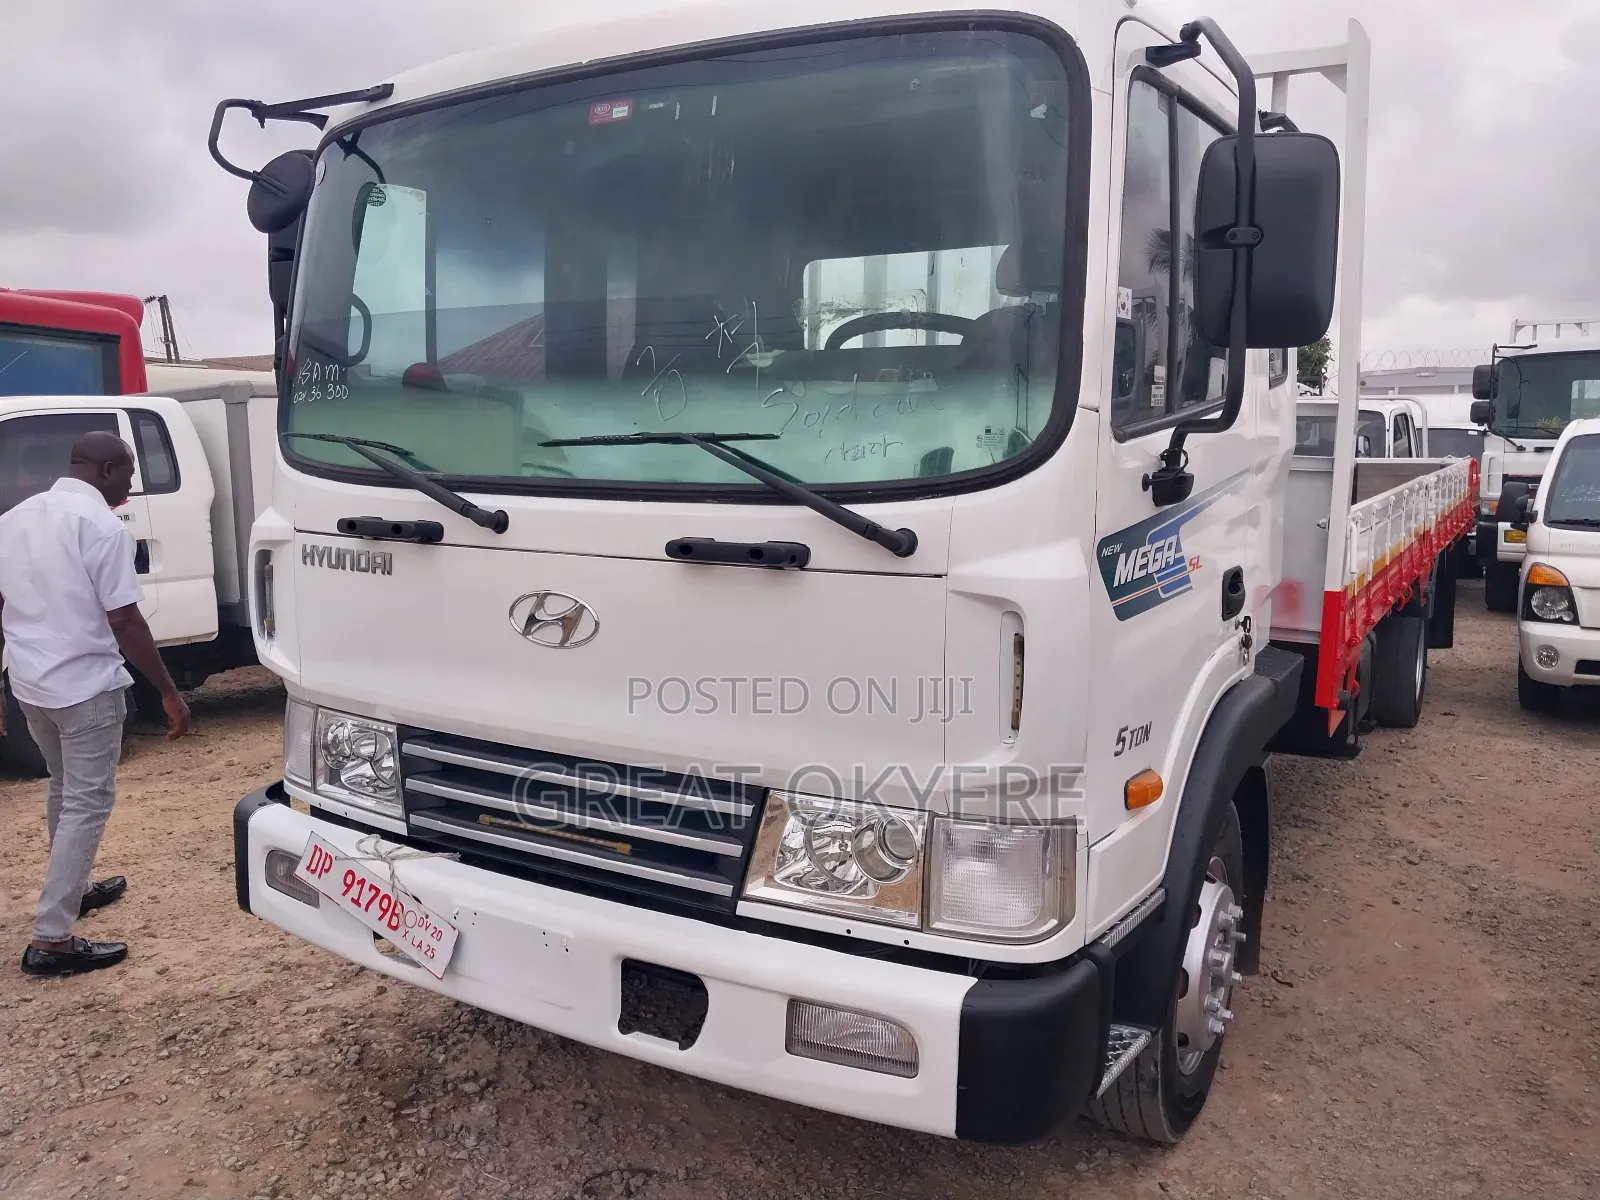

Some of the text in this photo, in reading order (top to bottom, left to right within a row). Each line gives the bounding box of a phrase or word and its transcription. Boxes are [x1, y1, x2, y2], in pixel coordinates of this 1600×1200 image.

[301, 543, 393, 576] HYUNDAI
[1101, 543, 1123, 557] NEW
[1113, 535, 1203, 588] MEGA SL
[1113, 720, 1153, 758] 5 TON
[305, 844, 334, 880] DP
[423, 943, 437, 960] 25
